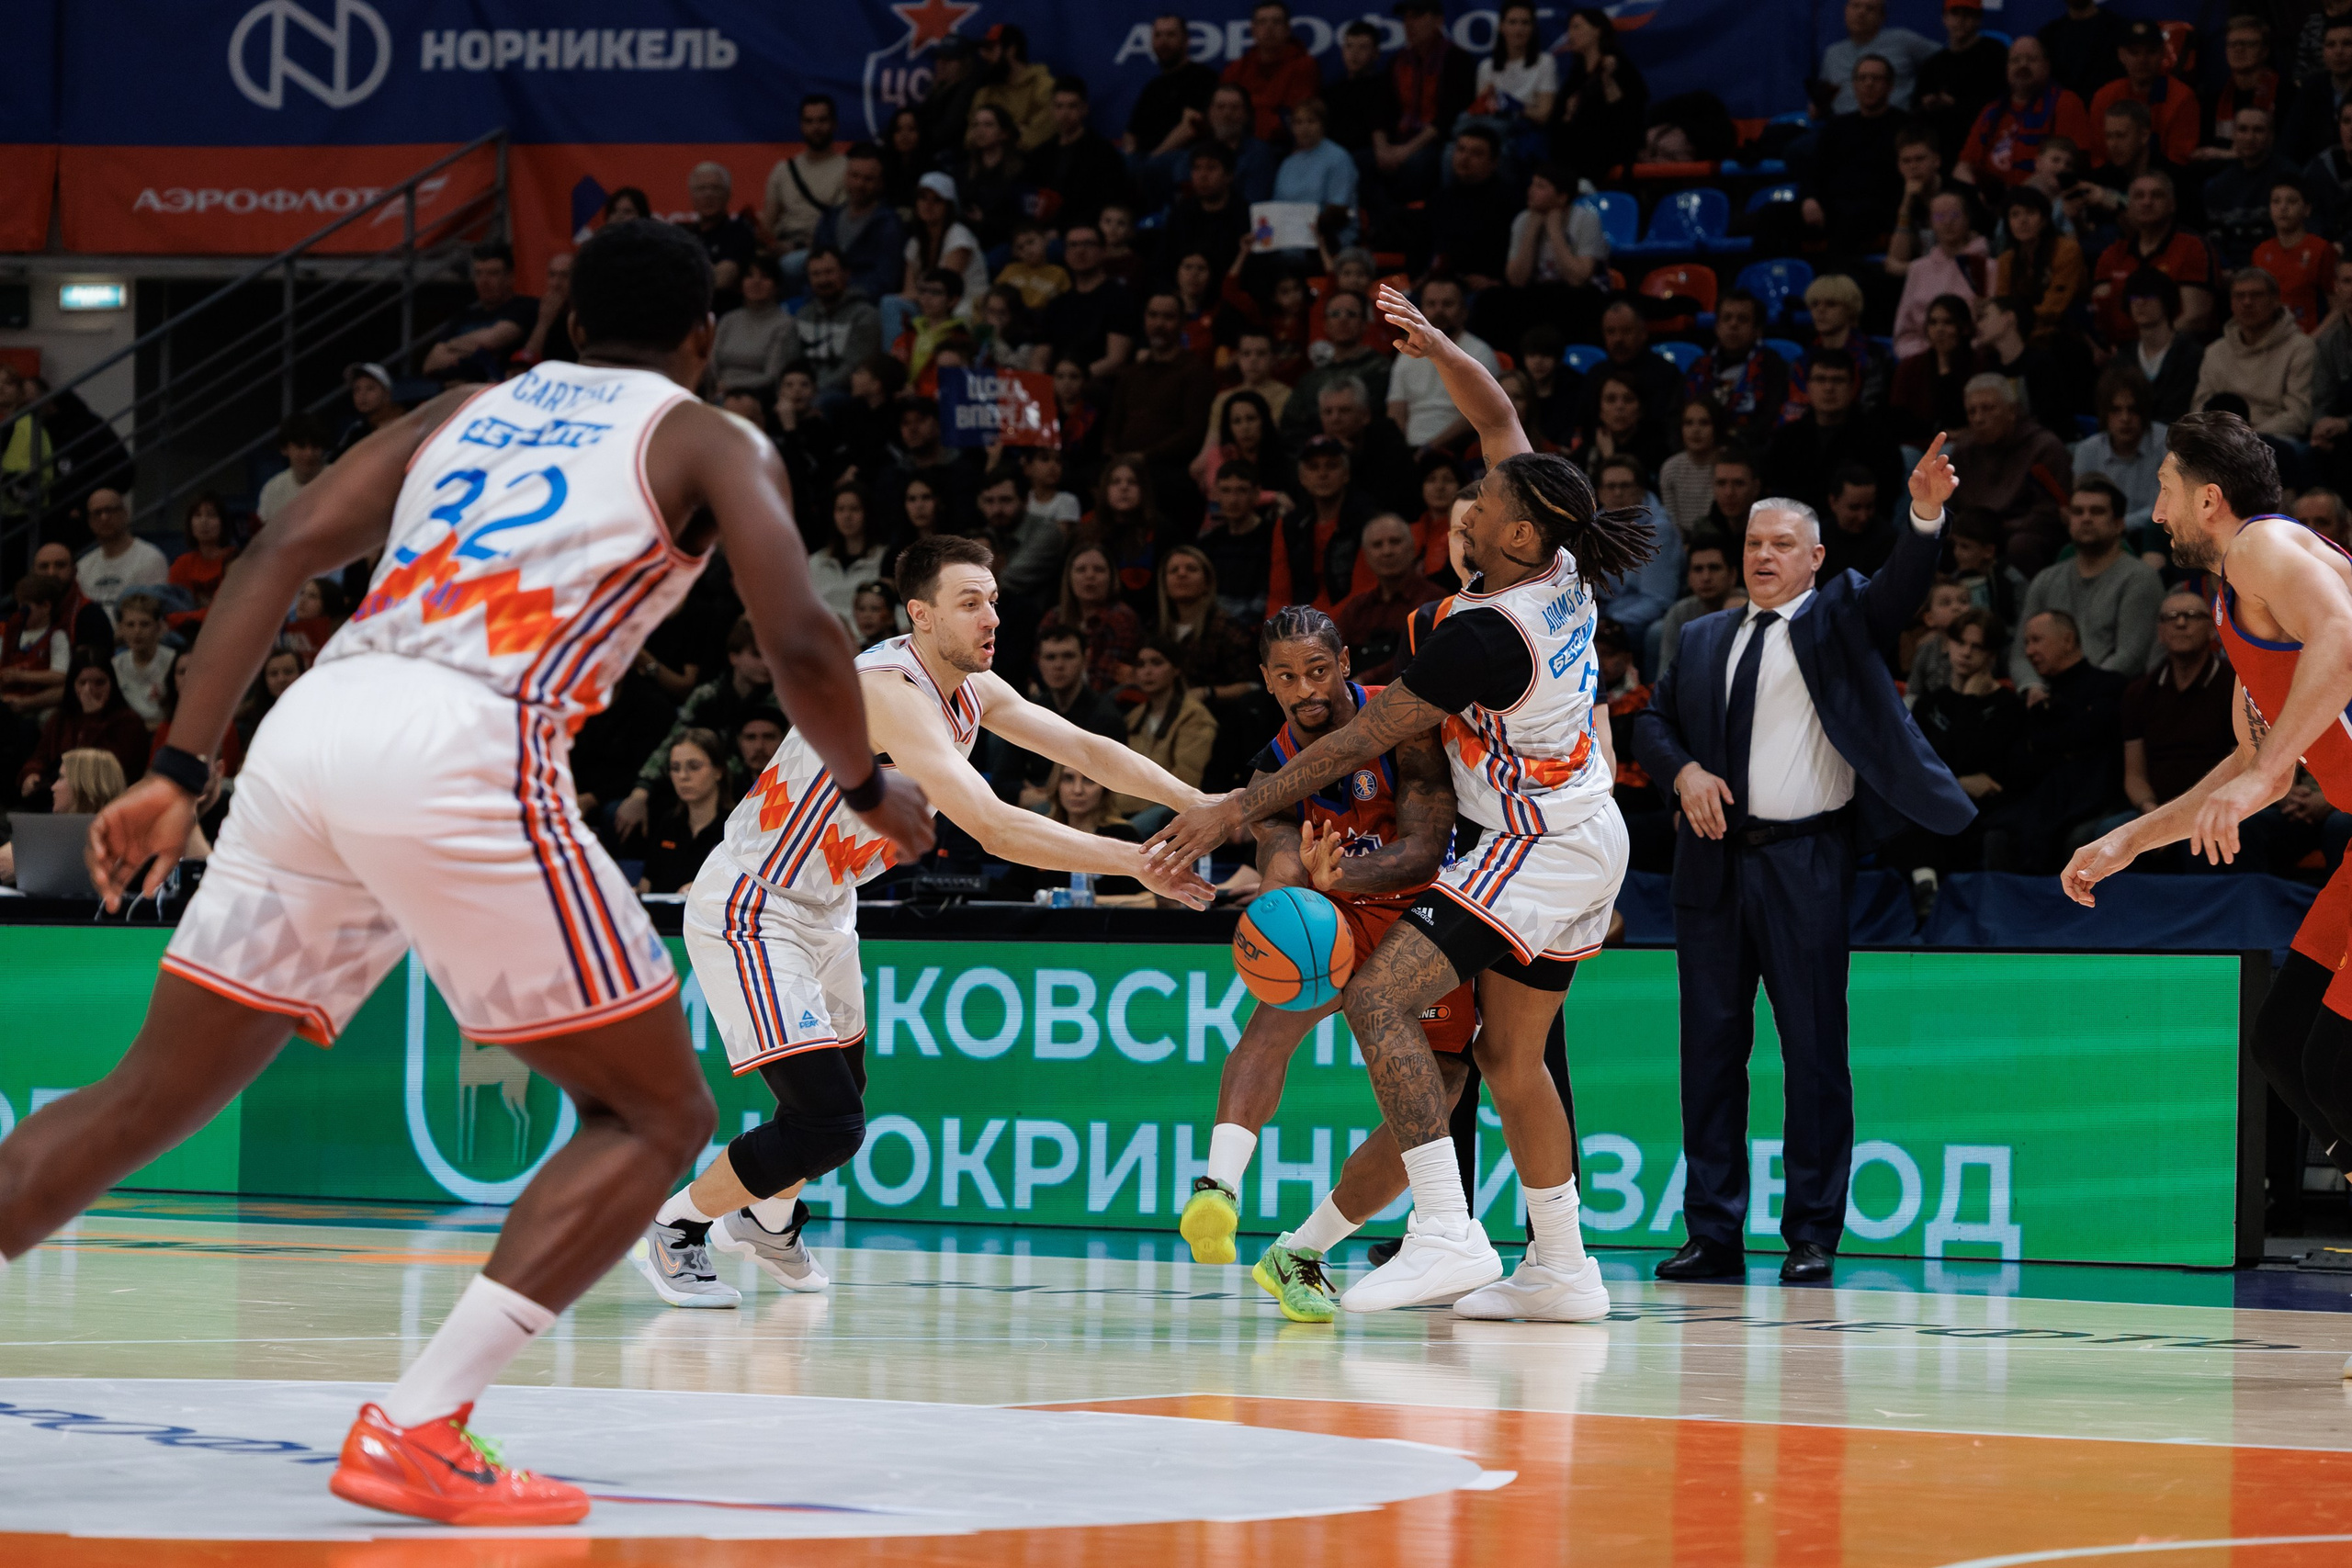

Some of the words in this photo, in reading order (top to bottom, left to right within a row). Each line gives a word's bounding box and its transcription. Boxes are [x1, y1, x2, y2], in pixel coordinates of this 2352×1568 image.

[420, 28, 739, 72] НОРНИКЕЛЬ
[1113, 7, 1556, 65] АЭРОФО
[880, 66, 933, 108] ЦС
[133, 186, 388, 215] АЭРОФЛОТ
[395, 465, 568, 565] 32
[1542, 588, 1576, 636] ADAMS
[1410, 908, 1434, 926] adidas
[798, 1019, 820, 1029] PEAK
